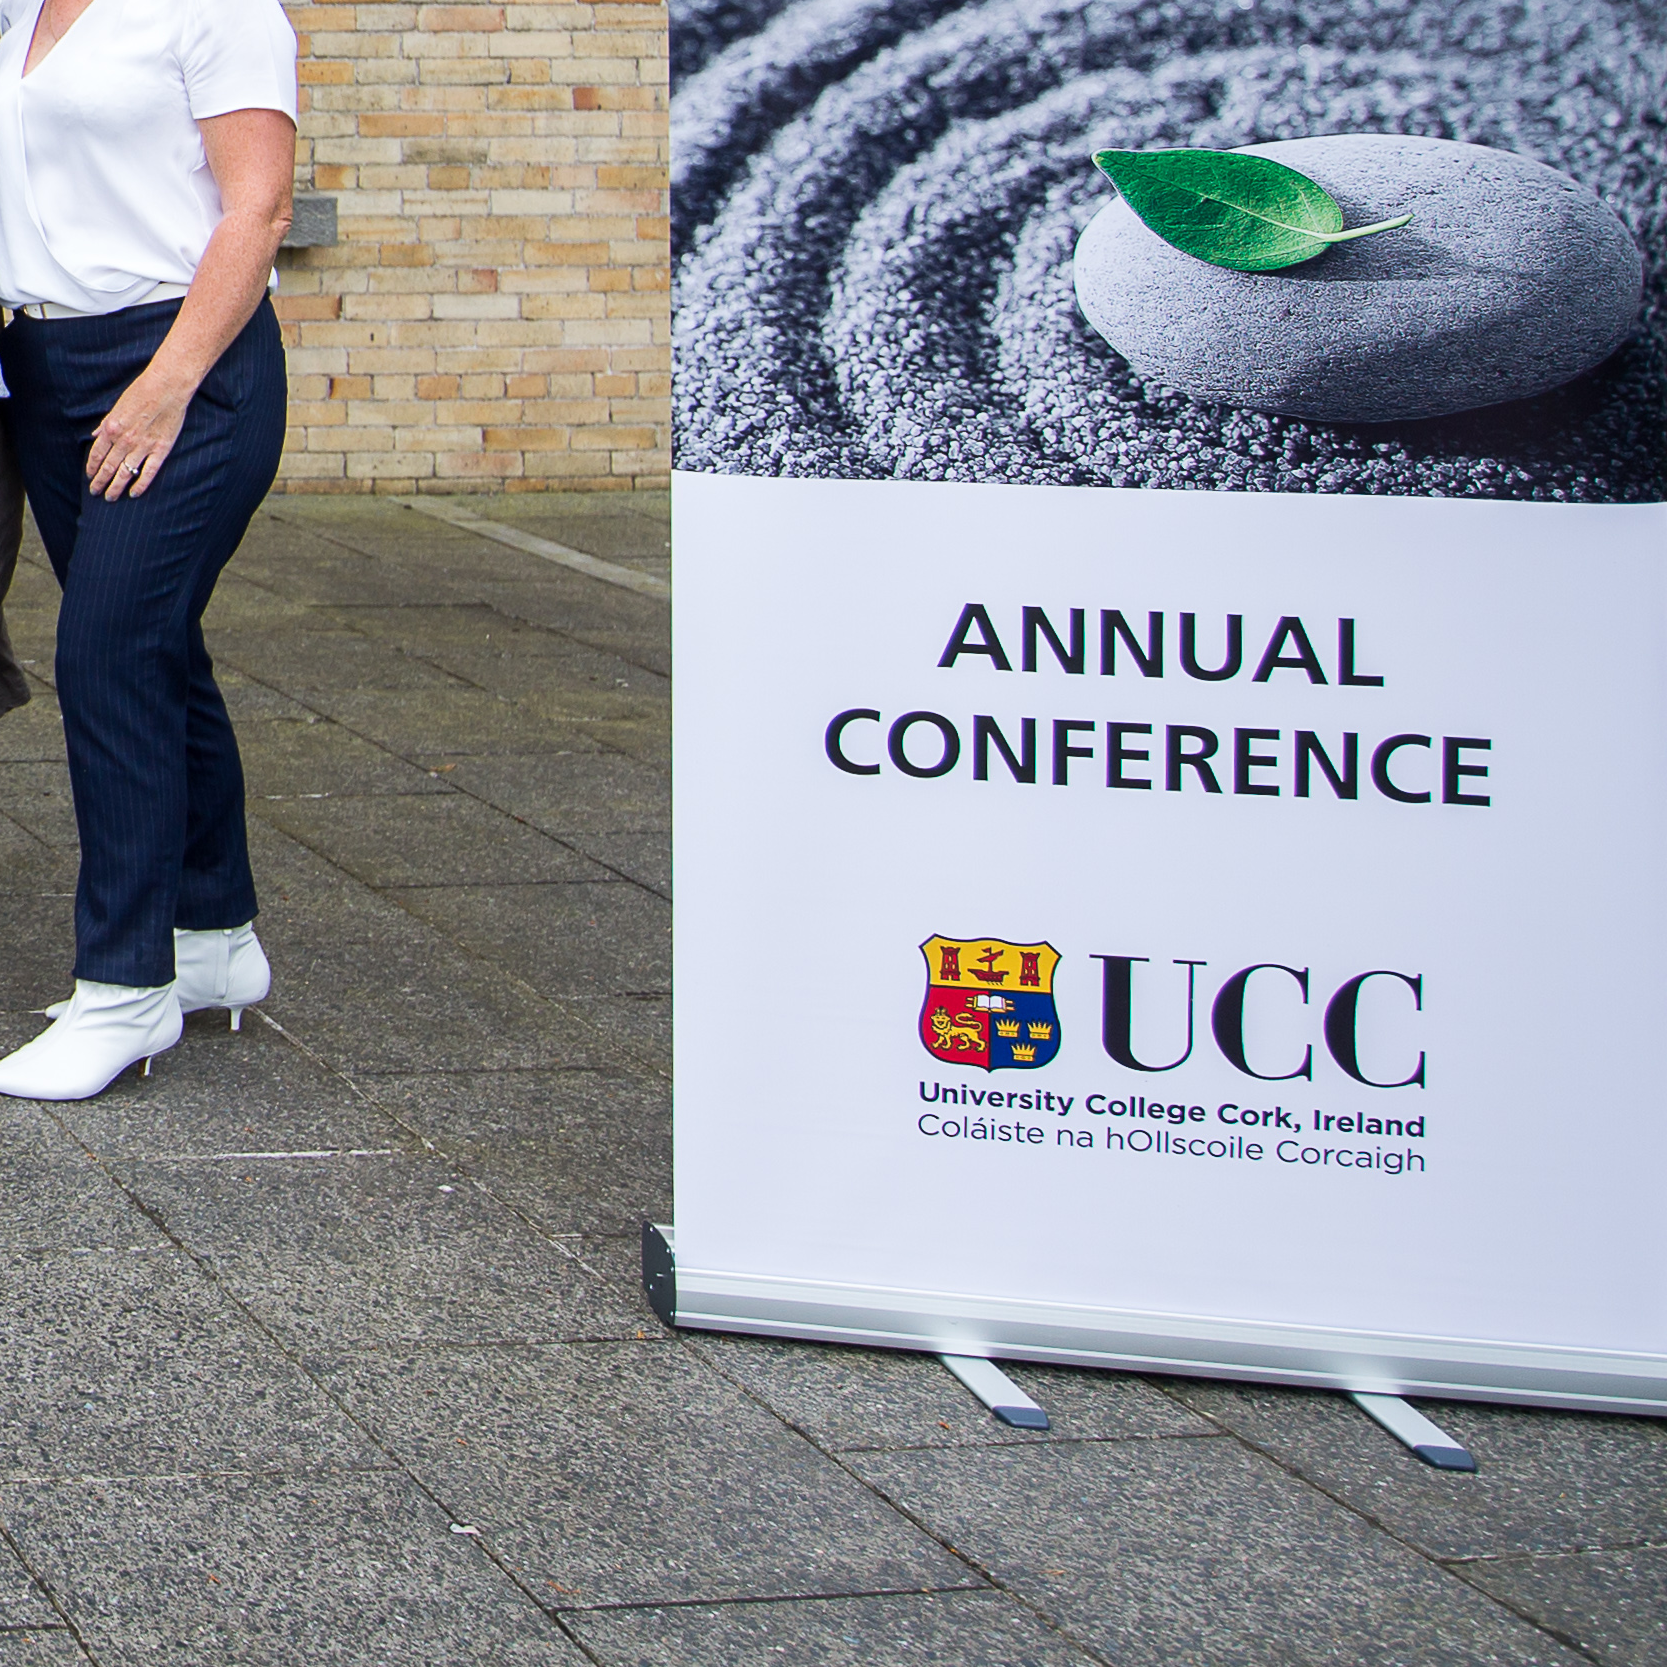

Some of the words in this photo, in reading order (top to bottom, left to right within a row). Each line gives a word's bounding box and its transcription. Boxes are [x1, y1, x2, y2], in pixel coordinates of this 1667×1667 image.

[936, 602, 1385, 688] ANNUAL
[824, 708, 1492, 808] CONFERENCE
[1088, 953, 1426, 1090] UCC
[917, 1113, 1045, 1145] Coláiste
[1057, 1129, 1094, 1148] na
[1106, 1126, 1264, 1161] hOllscoile
[1276, 1139, 1425, 1175] Corcaigh
[919, 1081, 1075, 1117] University
[1085, 1093, 1206, 1125] College
[1217, 1103, 1302, 1134] Cork,
[1313, 1109, 1425, 1138] Ireland
